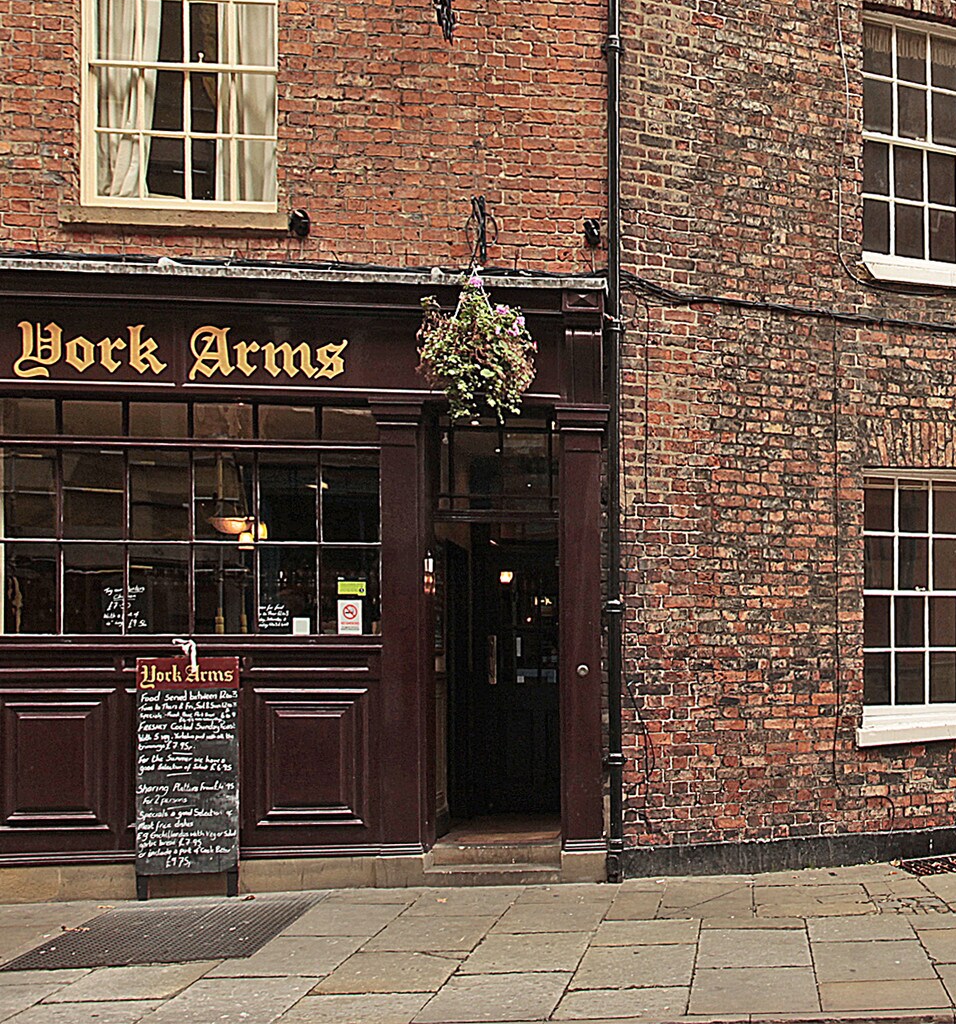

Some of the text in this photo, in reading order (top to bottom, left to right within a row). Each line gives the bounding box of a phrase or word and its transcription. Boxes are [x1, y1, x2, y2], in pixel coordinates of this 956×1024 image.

[13, 320, 349, 380] York Arms
[140, 664, 234, 689] York Arms
[140, 691, 161, 702] Food
[136, 783, 169, 798] Sharing
[153, 794, 161, 804] 2
